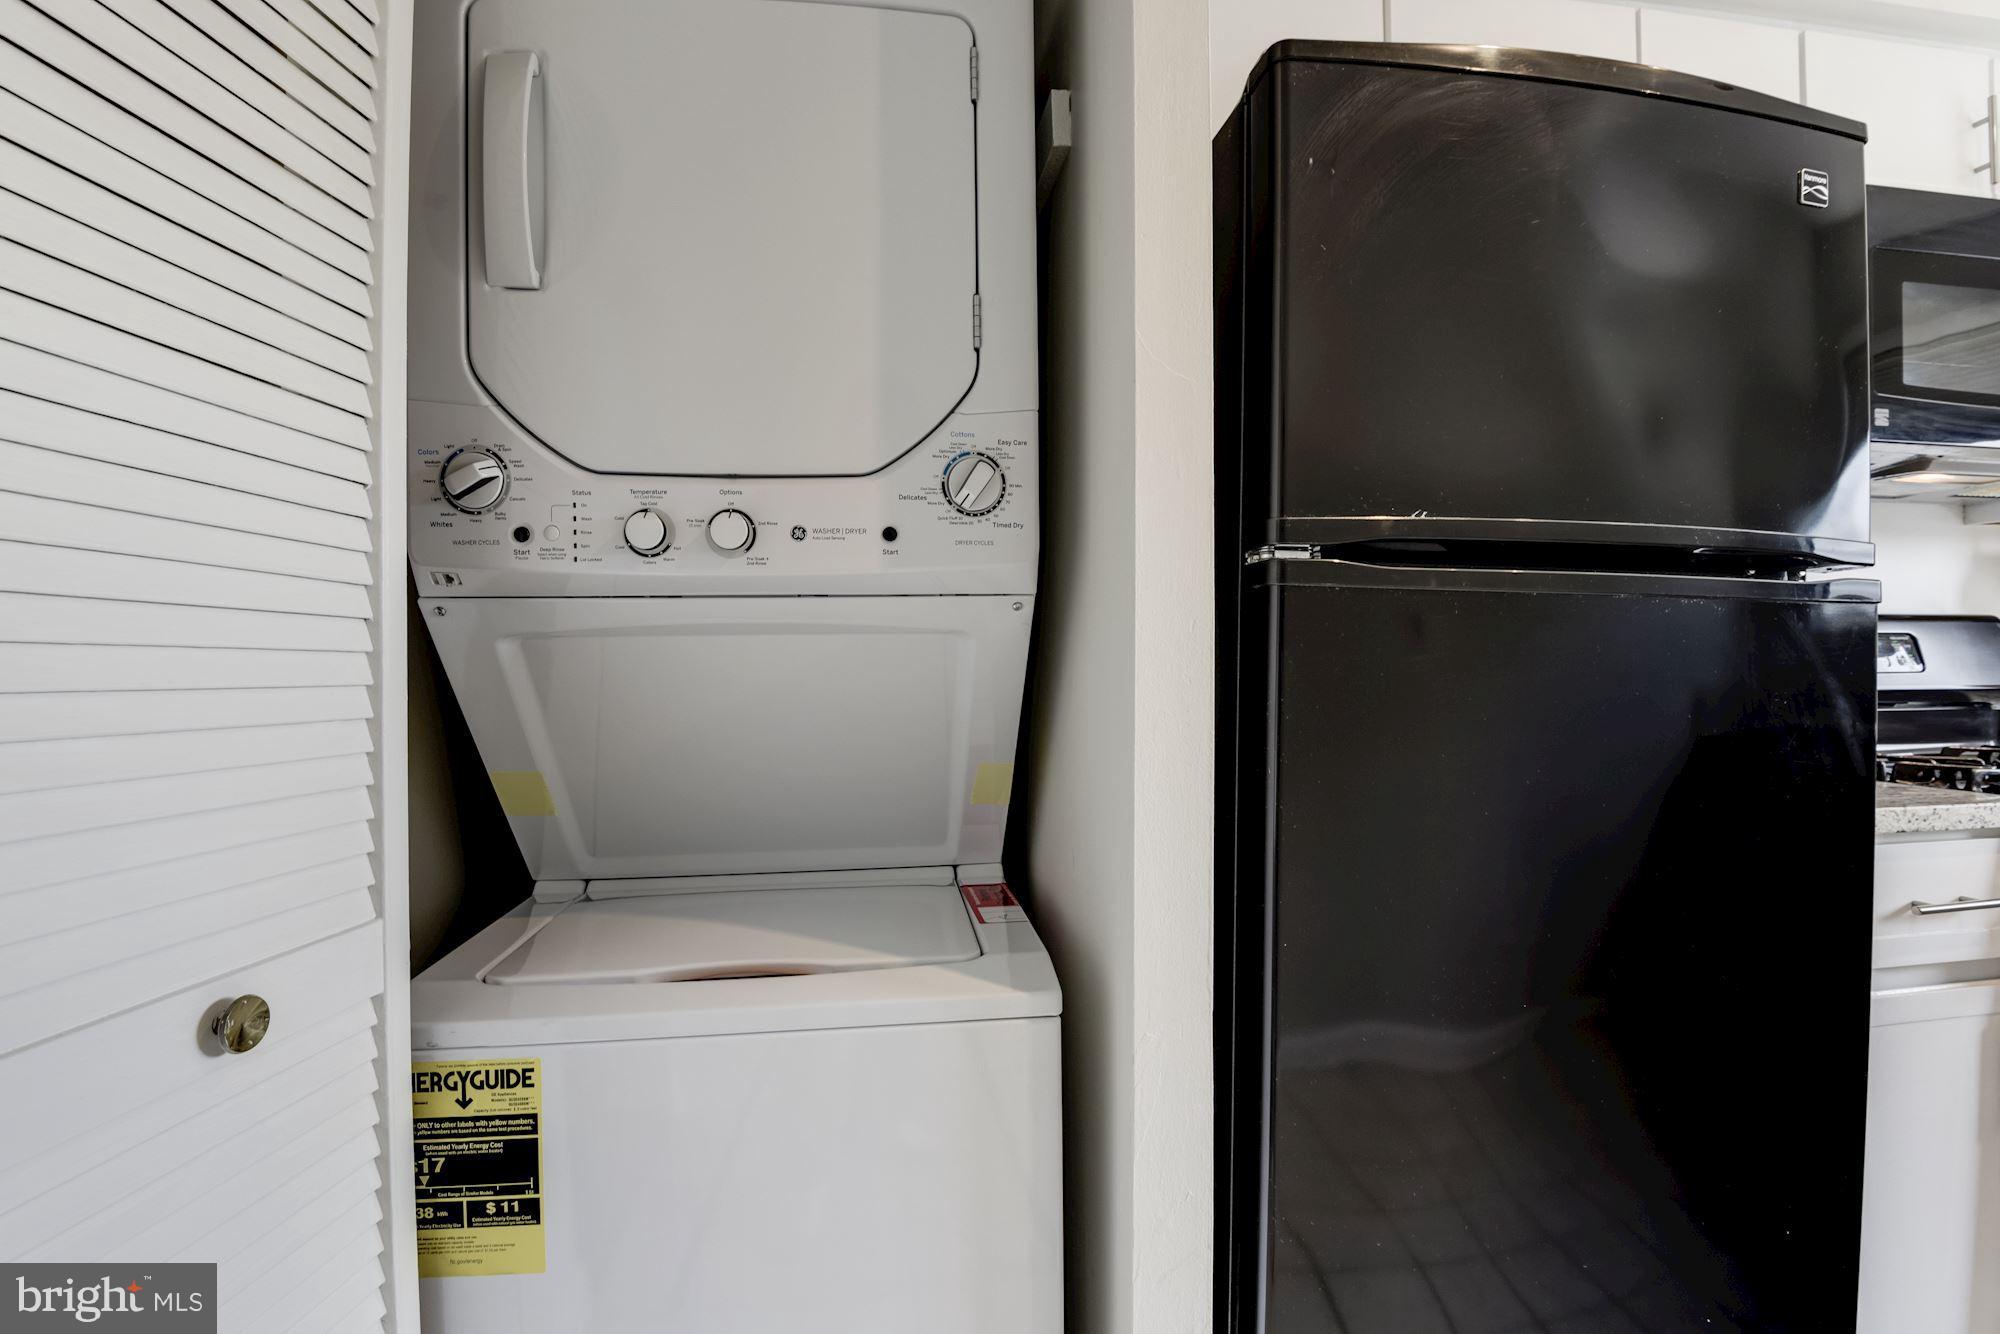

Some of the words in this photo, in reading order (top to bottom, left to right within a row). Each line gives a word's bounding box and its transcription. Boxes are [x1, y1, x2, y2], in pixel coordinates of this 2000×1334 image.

[489, 1119, 507, 1127] yellow
[451, 1143, 469, 1151] Yearly
[469, 1142, 489, 1150] Energy
[486, 1202, 497, 1215] $
[500, 1201, 519, 1213] 11
